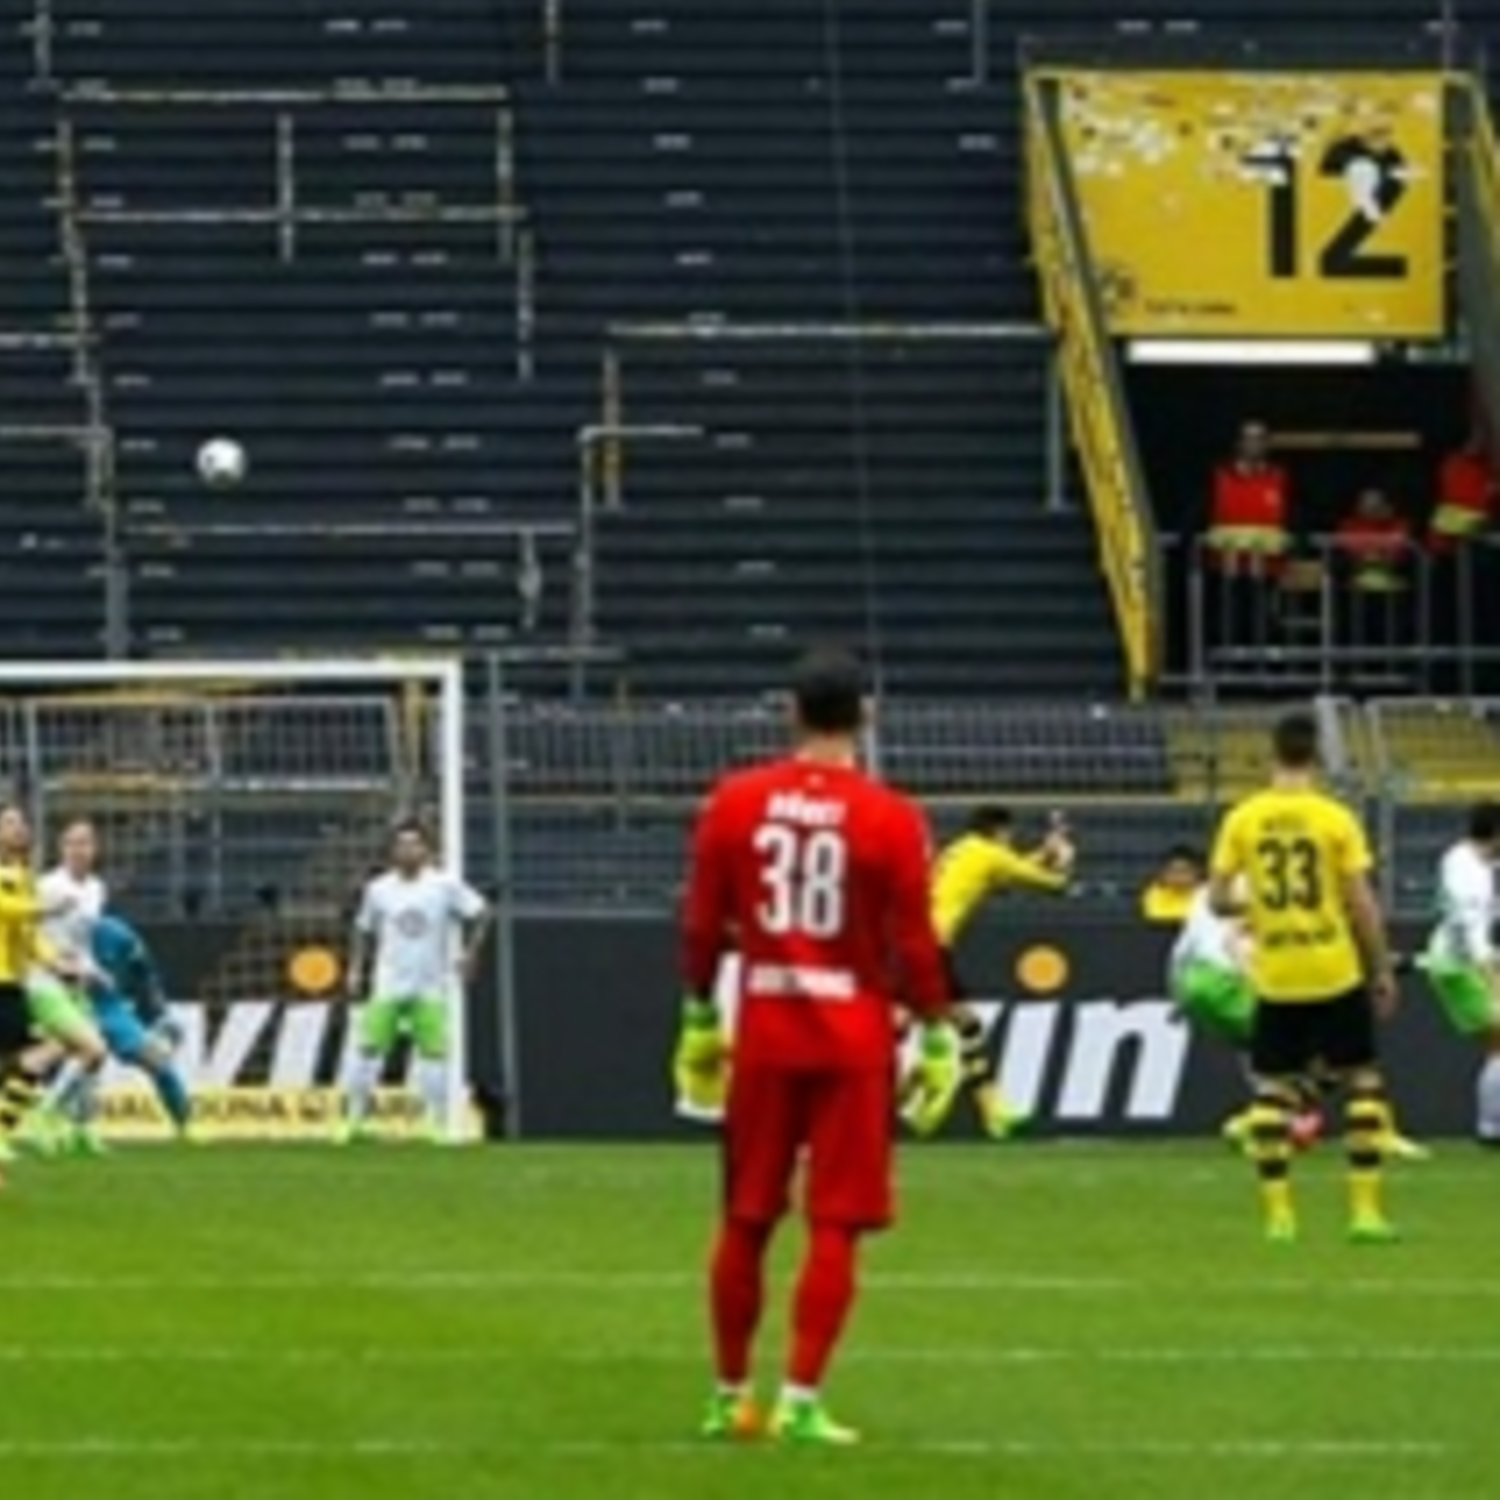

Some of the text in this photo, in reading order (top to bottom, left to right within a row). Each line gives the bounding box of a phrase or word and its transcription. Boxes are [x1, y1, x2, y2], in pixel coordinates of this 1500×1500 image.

[1243, 134, 1408, 280] 12
[753, 823, 847, 939] 38
[1257, 836, 1322, 912] 33
